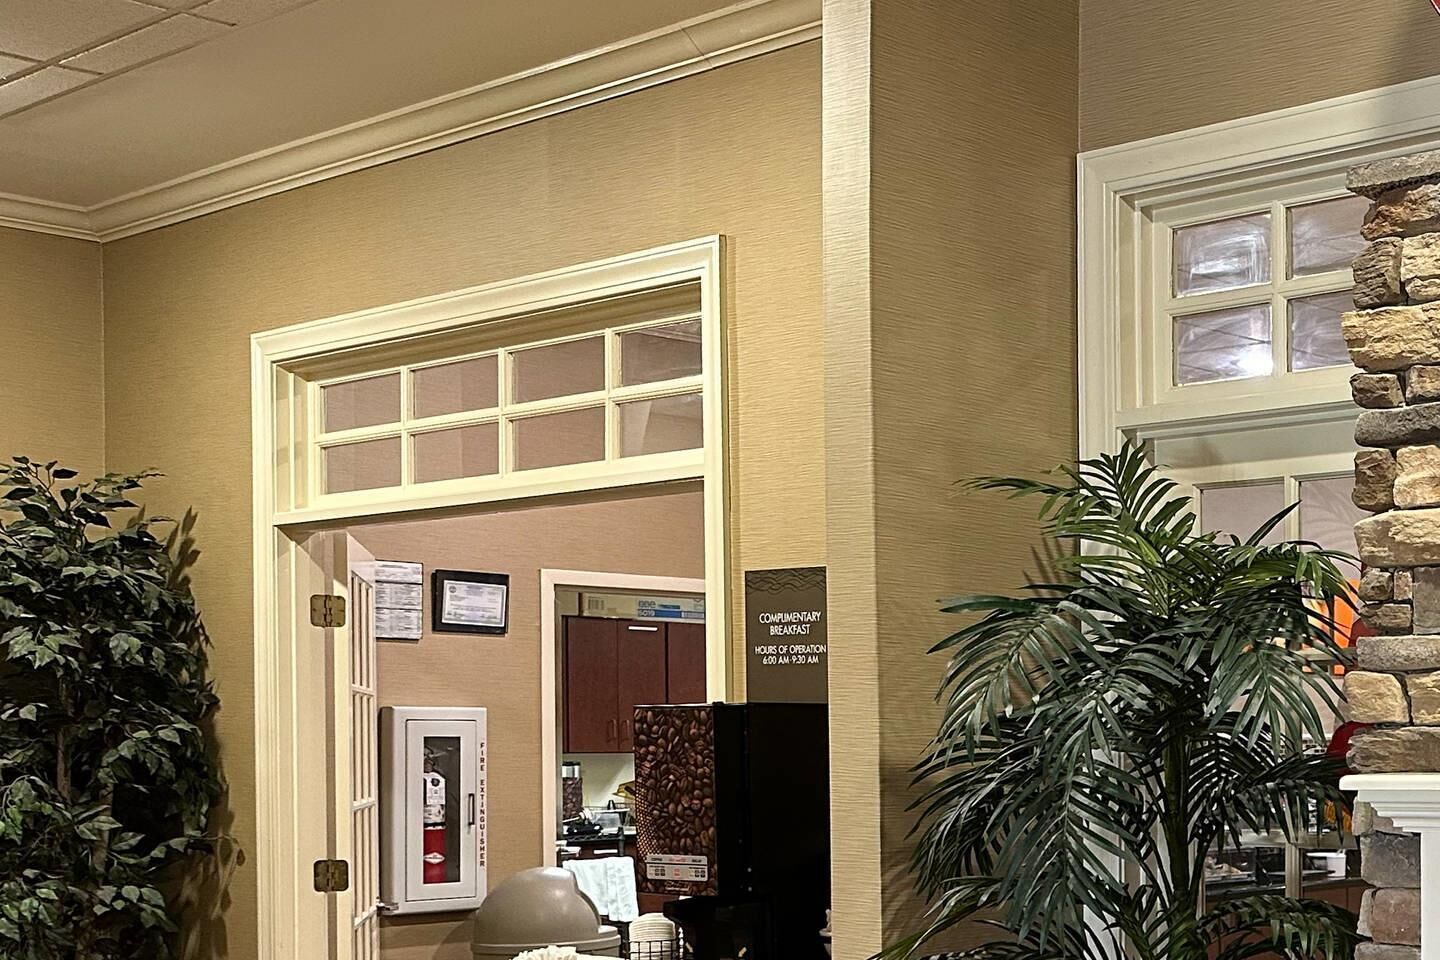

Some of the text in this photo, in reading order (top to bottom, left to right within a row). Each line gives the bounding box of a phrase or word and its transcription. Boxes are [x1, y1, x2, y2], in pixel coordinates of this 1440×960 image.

[759, 612, 821, 623] COMPLIMENTARY
[770, 624, 810, 635] BREAKFAST
[755, 645, 826, 654] HOURS OF OPERATION
[763, 656, 776, 664] 6:00
[807, 656, 819, 664] AM
